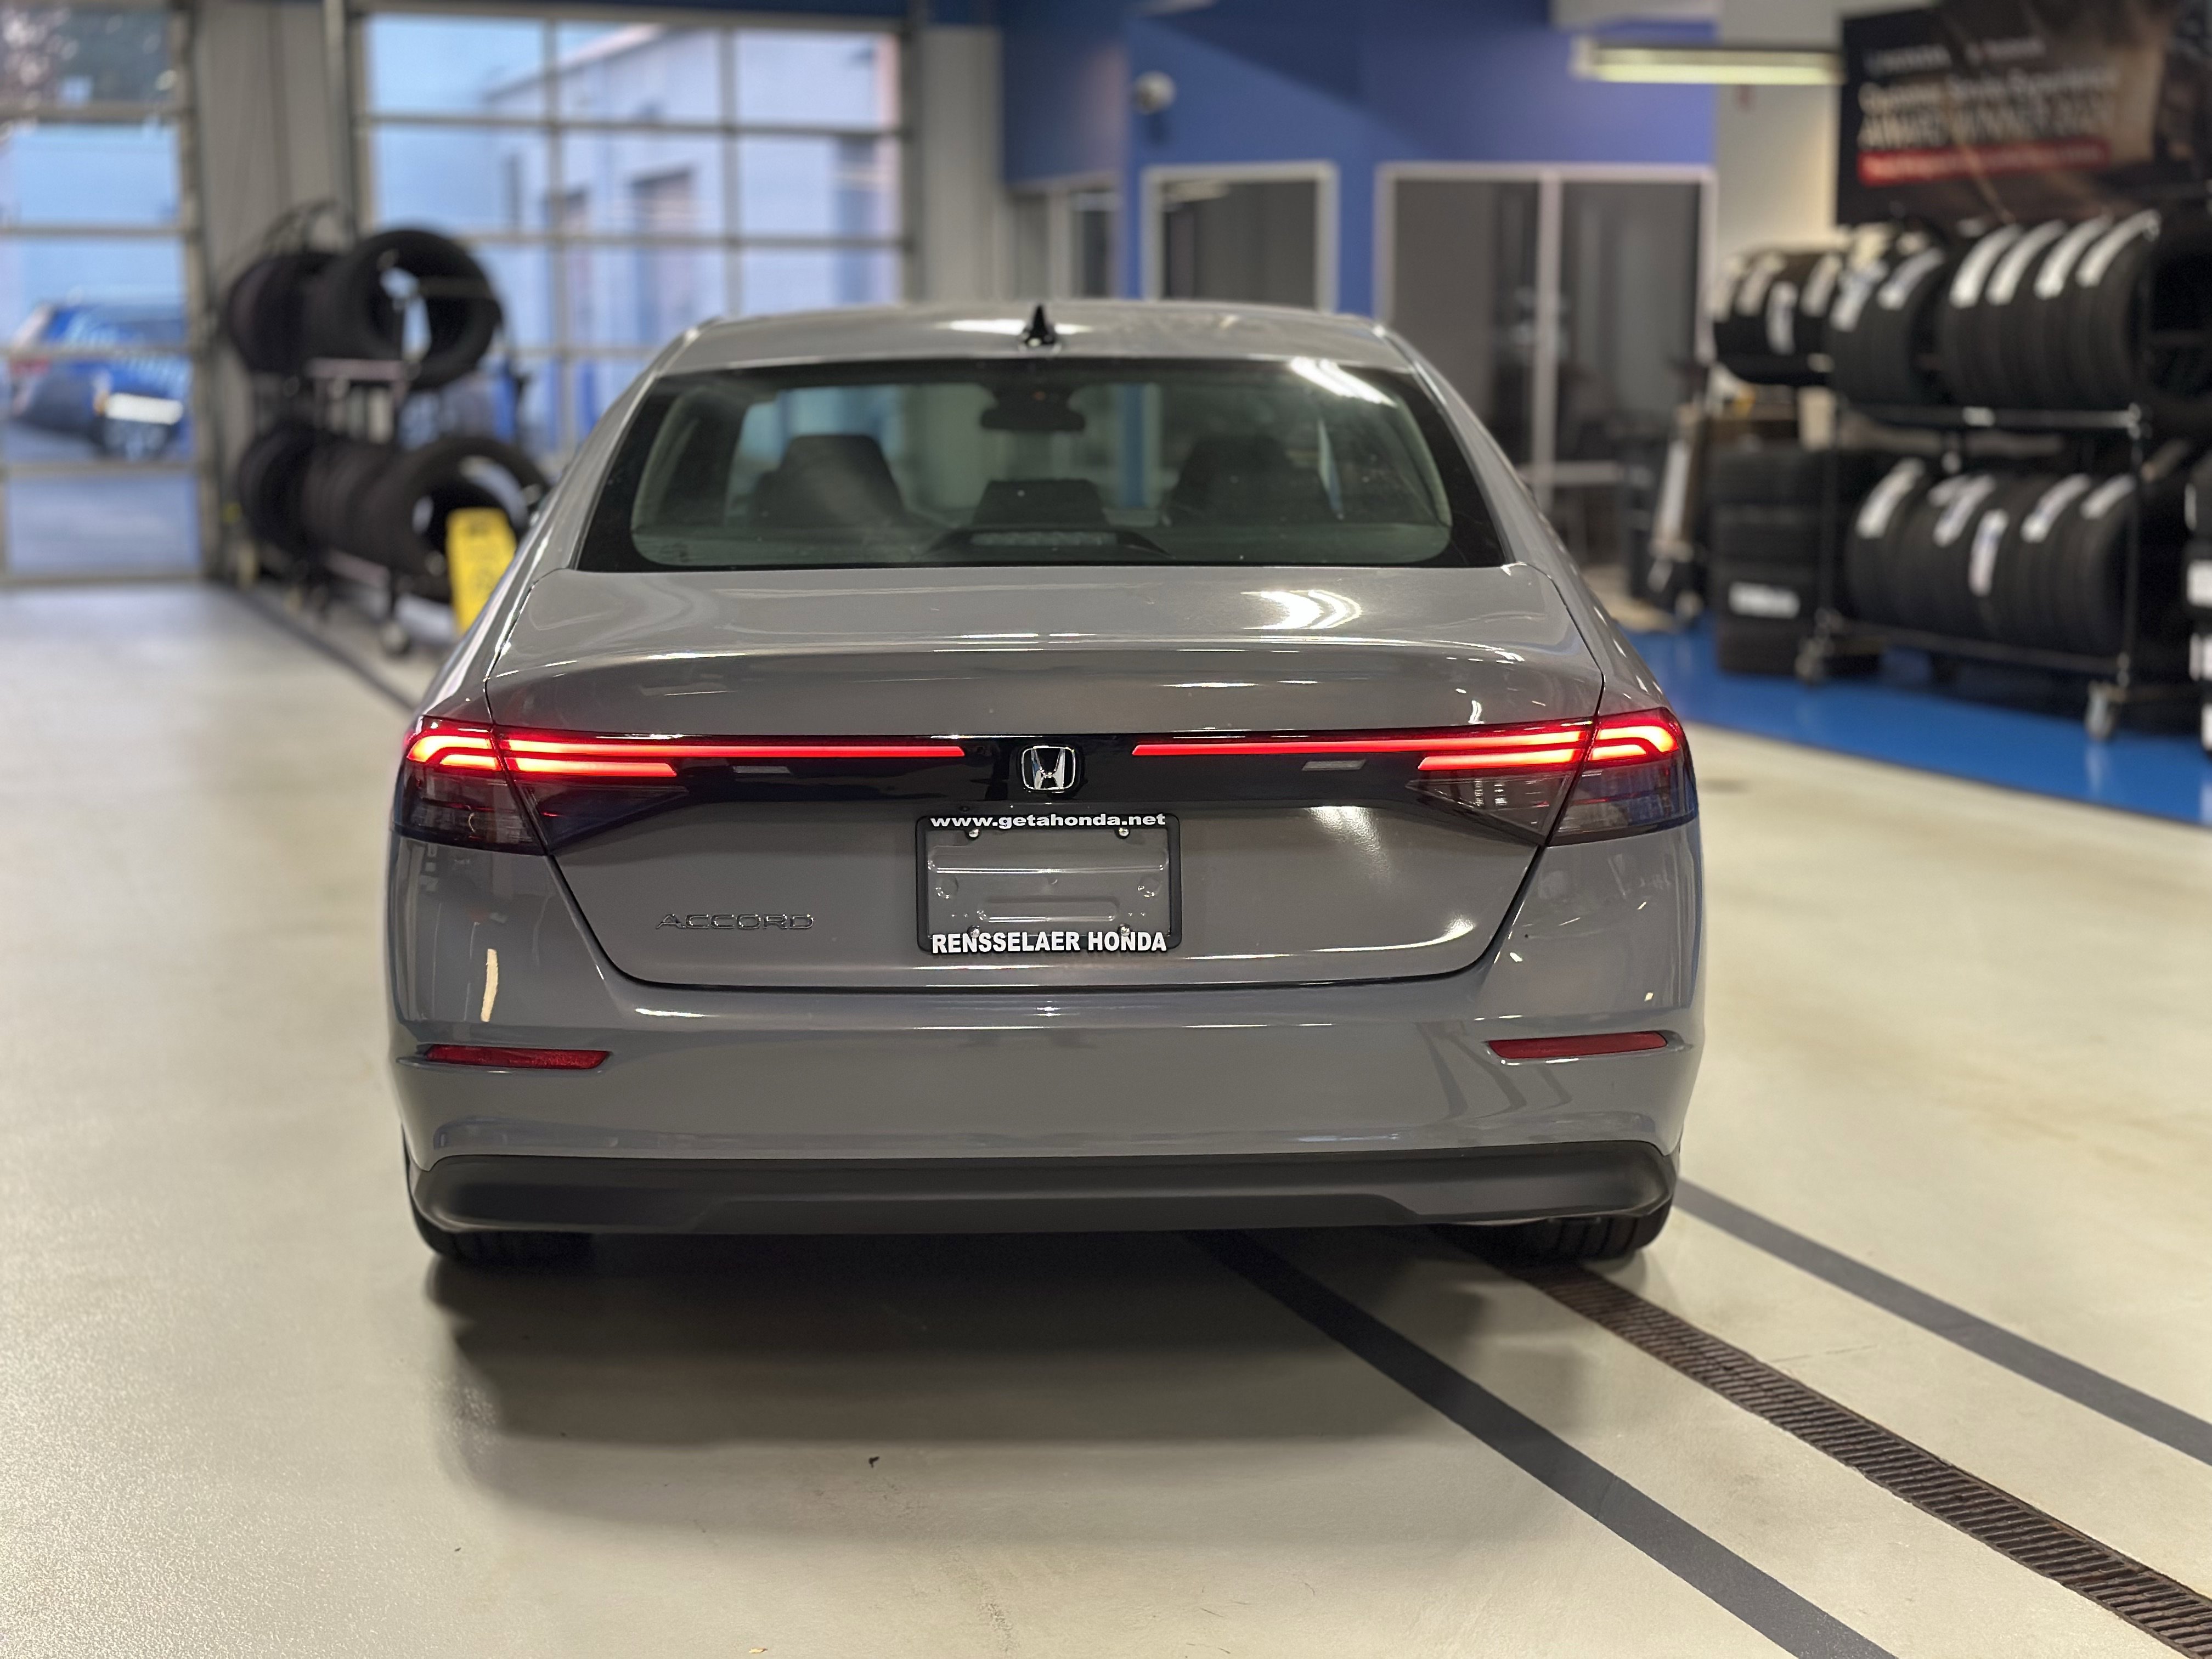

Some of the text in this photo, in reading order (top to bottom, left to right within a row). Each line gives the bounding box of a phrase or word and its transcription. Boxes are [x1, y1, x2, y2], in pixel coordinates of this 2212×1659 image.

[930, 814, 1166, 830] www.getahonda.net
[656, 913, 815, 930] ACCORD
[932, 930, 1167, 953] RENSSELAER HONDA
